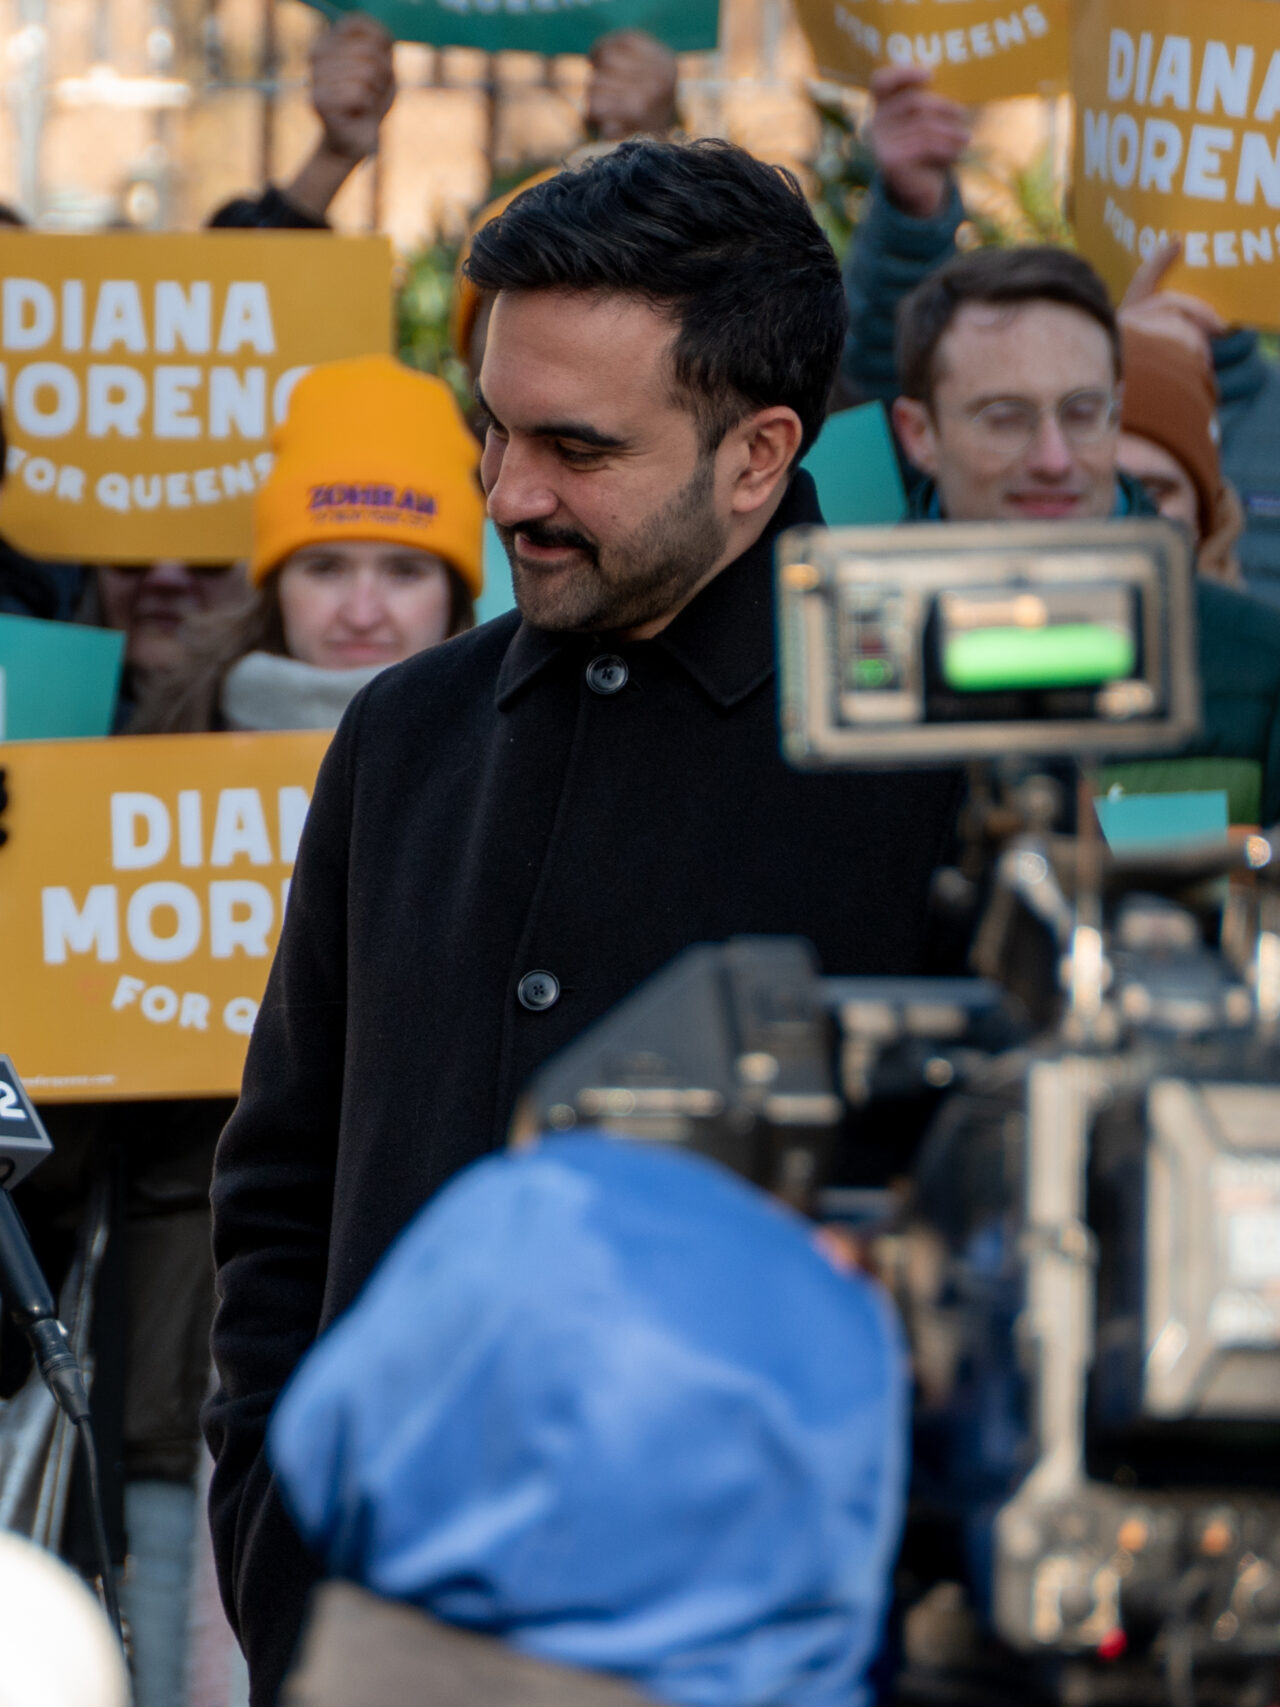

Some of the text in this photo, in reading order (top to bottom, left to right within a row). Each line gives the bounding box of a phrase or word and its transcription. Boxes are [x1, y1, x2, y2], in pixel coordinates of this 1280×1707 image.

[885, 4, 1049, 69] QUEENS
[1, 276, 277, 356] DIANA
[111, 975, 211, 1031] FOR
